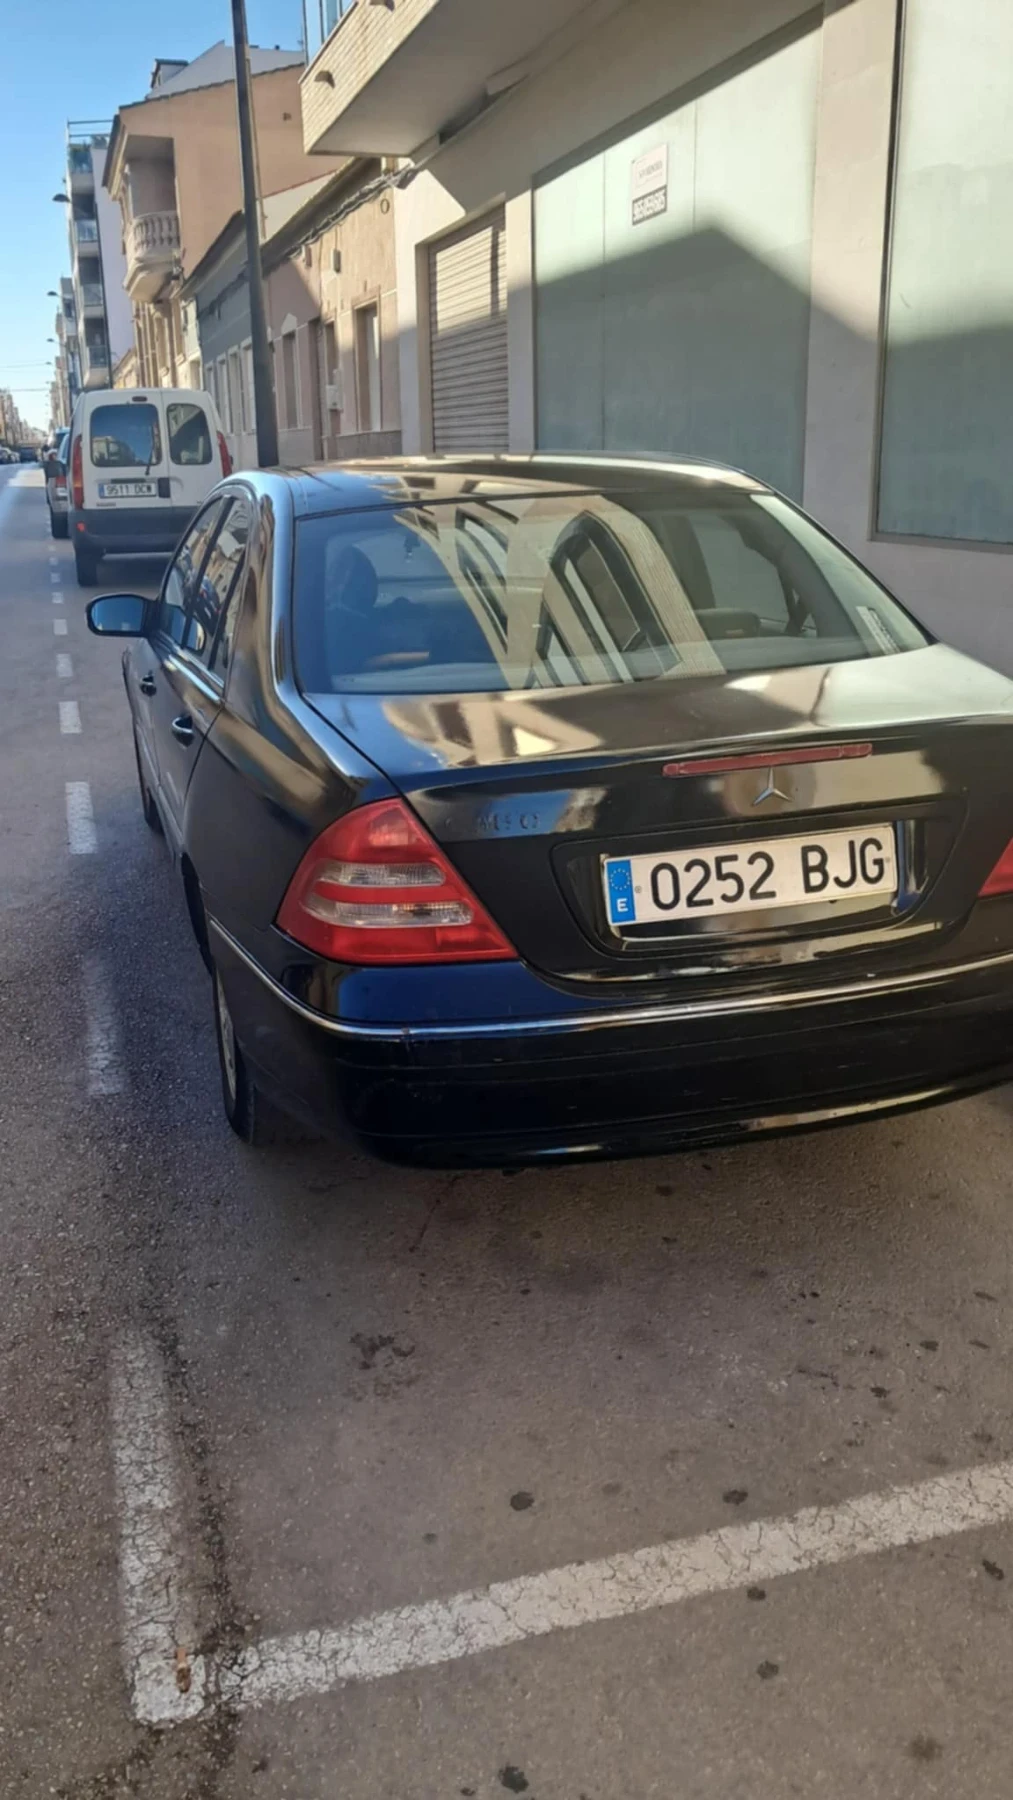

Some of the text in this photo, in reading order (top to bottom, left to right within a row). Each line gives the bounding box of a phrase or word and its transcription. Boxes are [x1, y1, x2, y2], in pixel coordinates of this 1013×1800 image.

[650, 837, 885, 910] 0252 BJG
[616, 898, 629, 912] E
